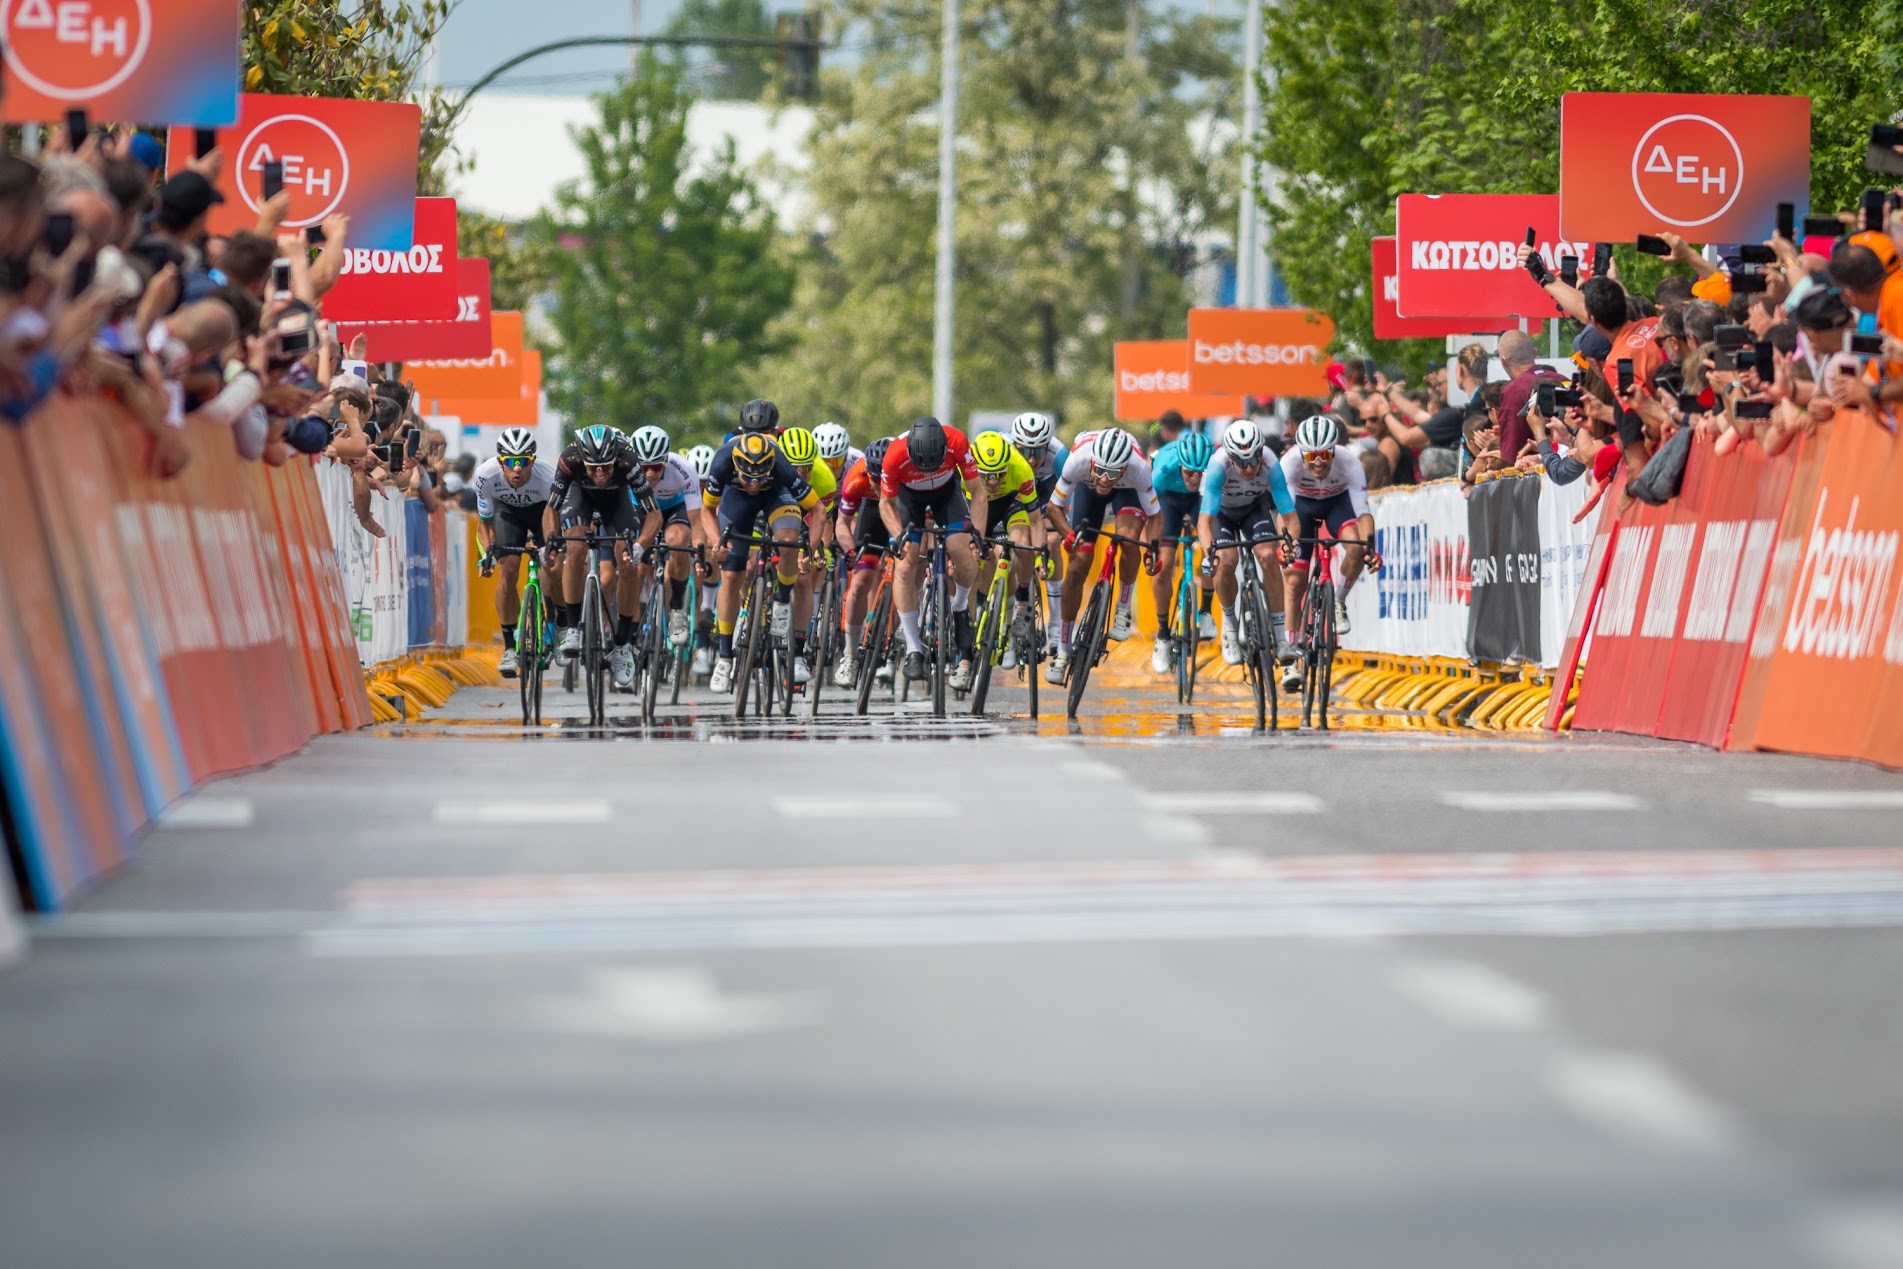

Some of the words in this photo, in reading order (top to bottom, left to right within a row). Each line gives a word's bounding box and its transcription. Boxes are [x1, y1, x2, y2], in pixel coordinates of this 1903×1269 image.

[14, 0, 127, 57] ΔΕΗ
[248, 143, 331, 196] ΔΕΗ
[1644, 145, 1726, 194] ΔΕΗ
[339, 244, 443, 275] ΟΒΟΛΟΣ
[1411, 241, 1588, 270] ΚΩΤΣΟΒΛΟΣ
[1195, 339, 1317, 366] betsson
[1783, 486, 1898, 660] betsson
